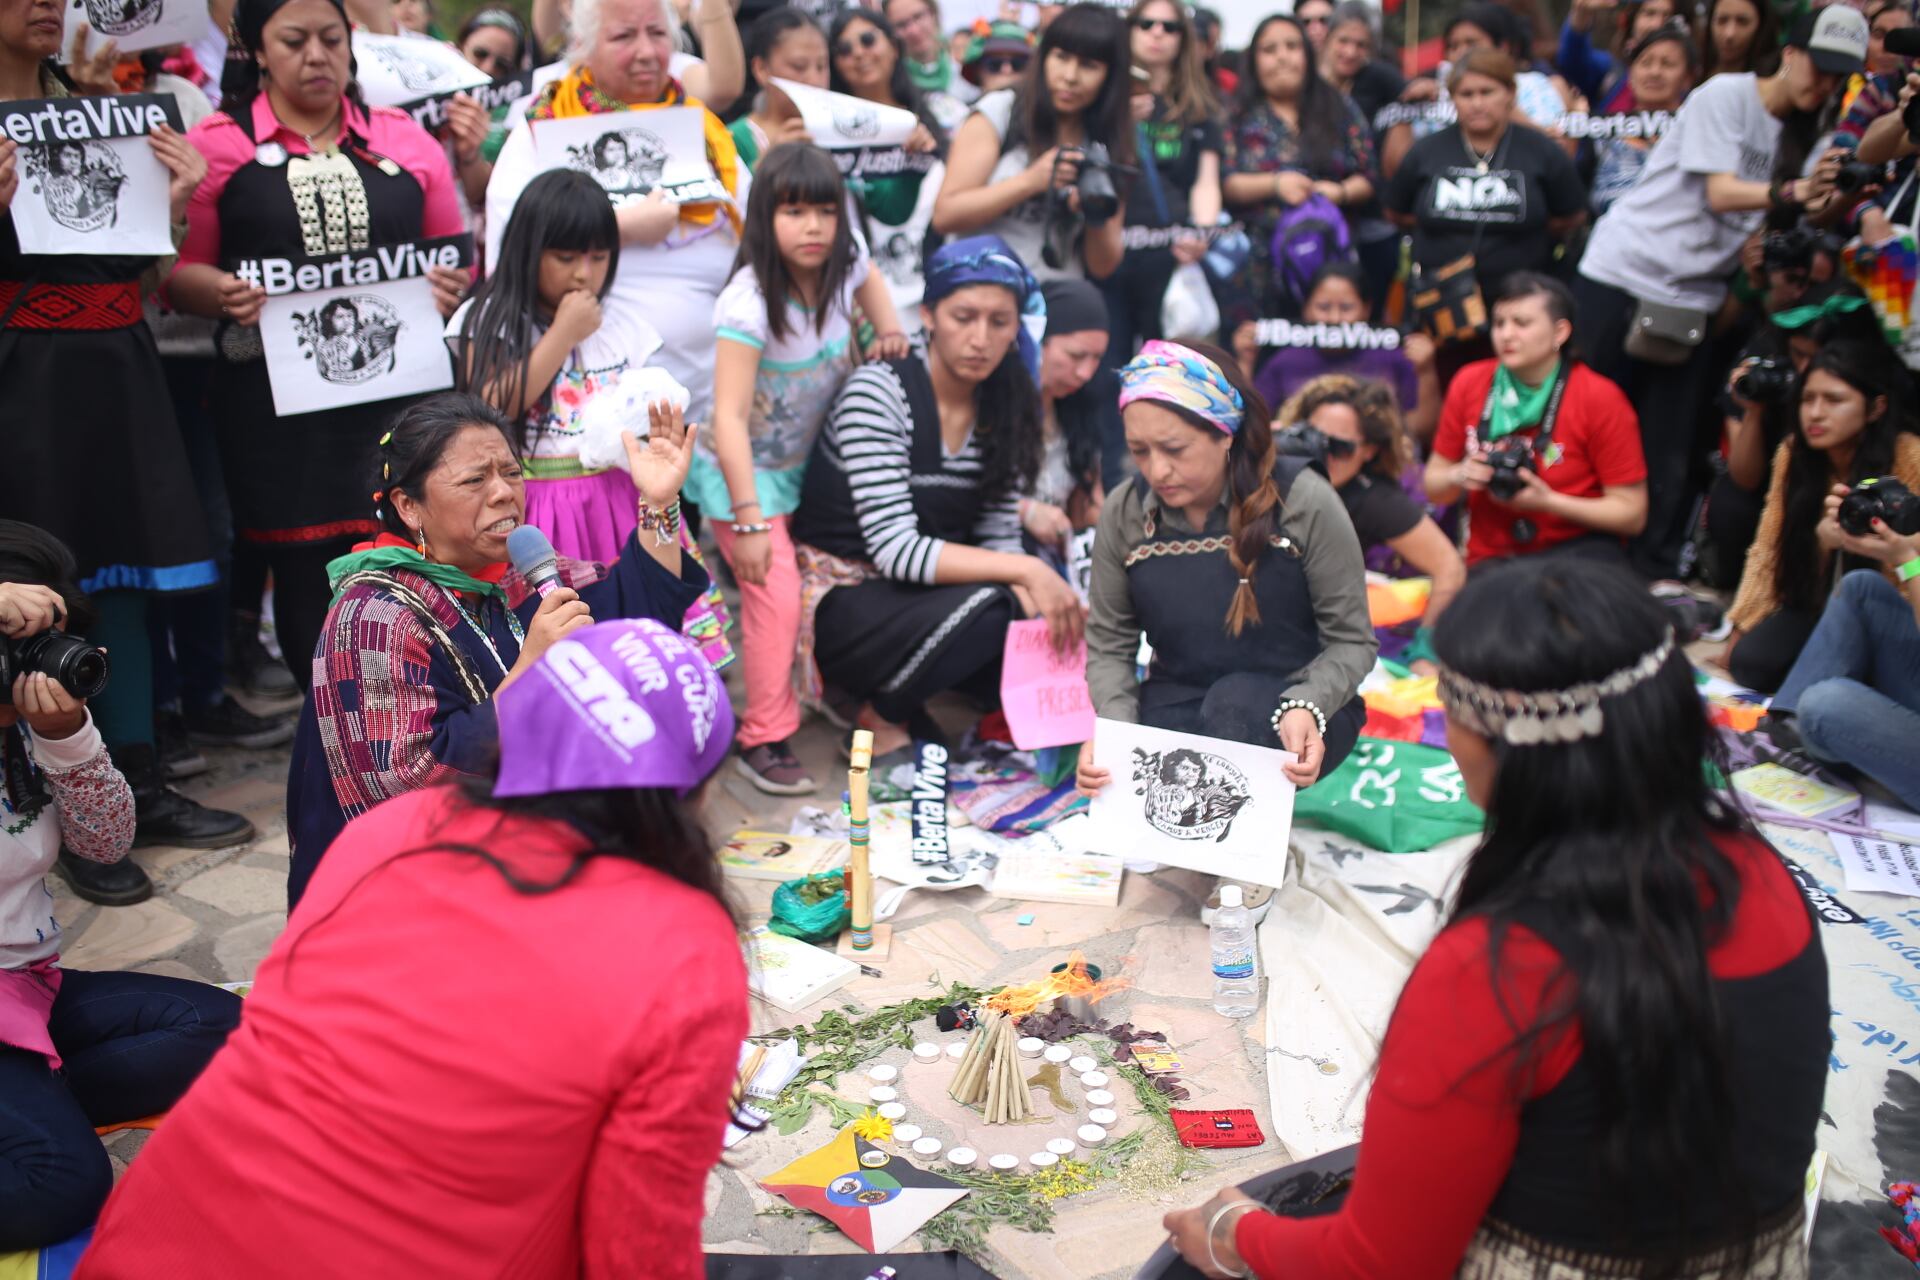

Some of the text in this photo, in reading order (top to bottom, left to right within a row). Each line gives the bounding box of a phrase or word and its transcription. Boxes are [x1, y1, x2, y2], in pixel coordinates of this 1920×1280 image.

[0, 98, 168, 144] ertaVive
[236, 242, 461, 296] #BertaVive
[1255, 318, 1400, 350] #BertaVive
[911, 742, 948, 862] #BertaVive
